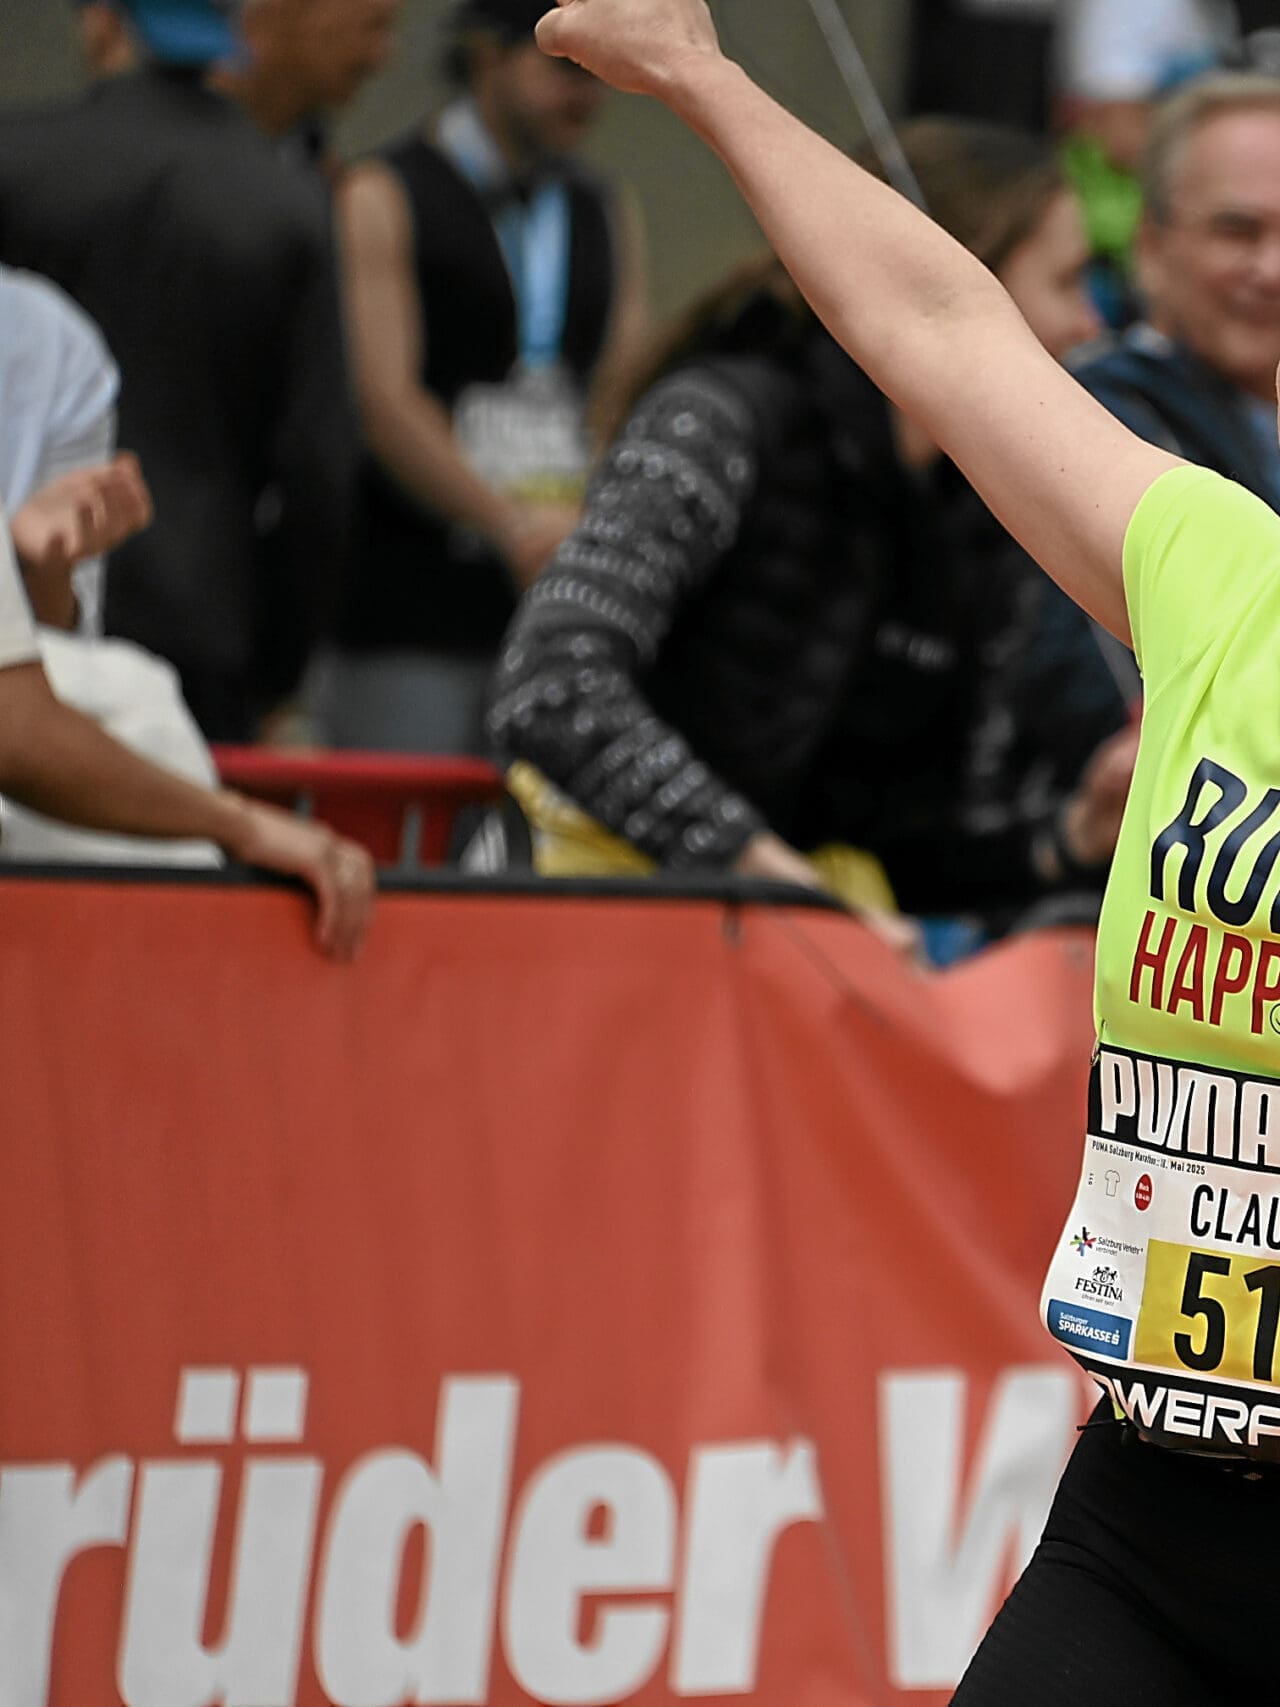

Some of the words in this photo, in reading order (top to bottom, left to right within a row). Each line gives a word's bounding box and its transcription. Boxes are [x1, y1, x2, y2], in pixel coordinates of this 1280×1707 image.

[1092, 1140, 1108, 1152] PUMA
[1109, 1145, 1134, 1161] Salzburg
[1170, 1160, 1184, 1171] Mai
[1186, 1163, 1205, 1175] 2025
[1098, 1236, 1122, 1251] Salzburg
[1075, 1277, 1123, 1302] FESTINA
[1058, 1320, 1112, 1344] SPARKASSE
